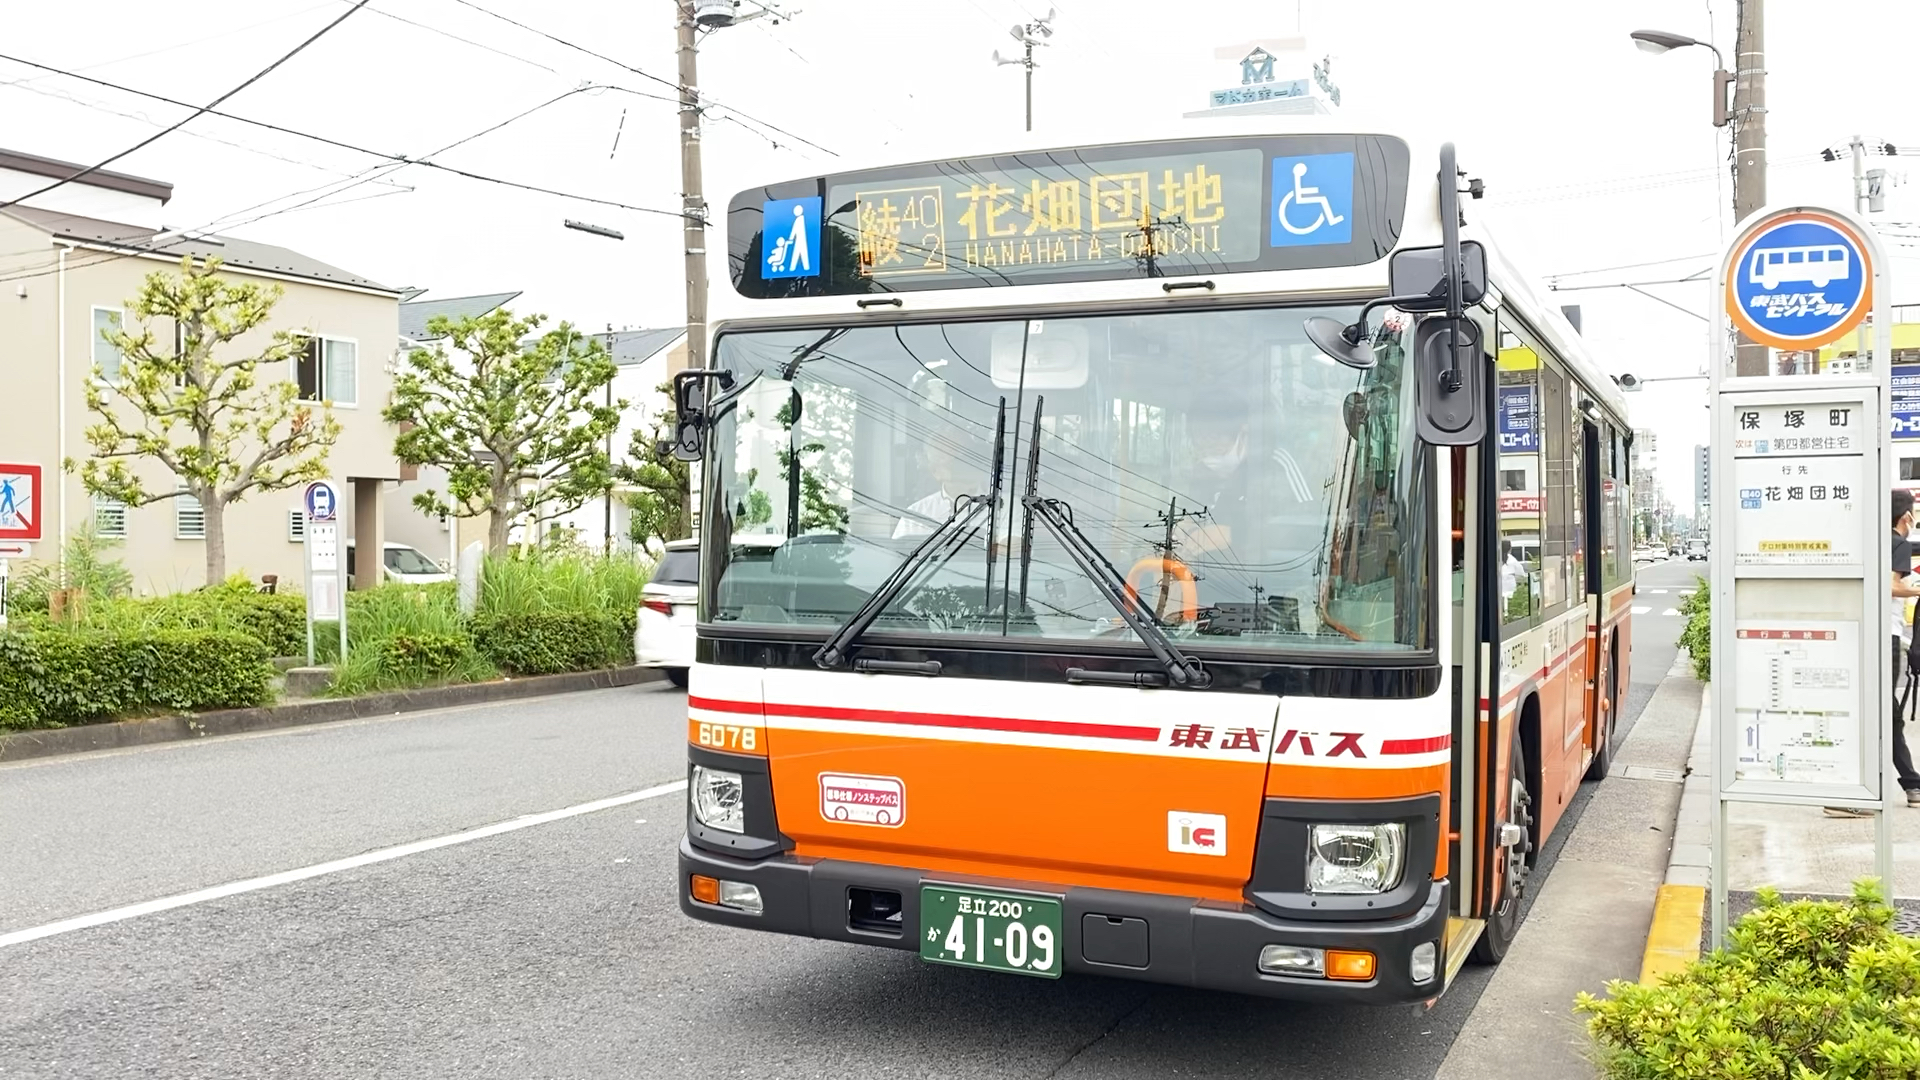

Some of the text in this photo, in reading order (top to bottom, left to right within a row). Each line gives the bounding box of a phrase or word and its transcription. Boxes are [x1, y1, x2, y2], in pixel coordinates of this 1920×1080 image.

[903, 195, 939, 229] 40
[955, 164, 1225, 240] 花畑団地
[965, 224, 1222, 269] HANAHATA-DANCHI
[1750, 292, 1825, 308] 東武バス
[1766, 302, 1848, 319] セントラル
[1740, 408, 1851, 430] 保塚町
[1773, 436, 1850, 450] 第四都営住宅
[1782, 465, 1808, 475] 行先
[1765, 485, 1850, 501] 花畑団地
[699, 723, 756, 750] 6078
[1168, 723, 1368, 759] 東武バス
[957, 896, 1022, 919] 足立200
[927, 914, 1054, 971] か 41-09
